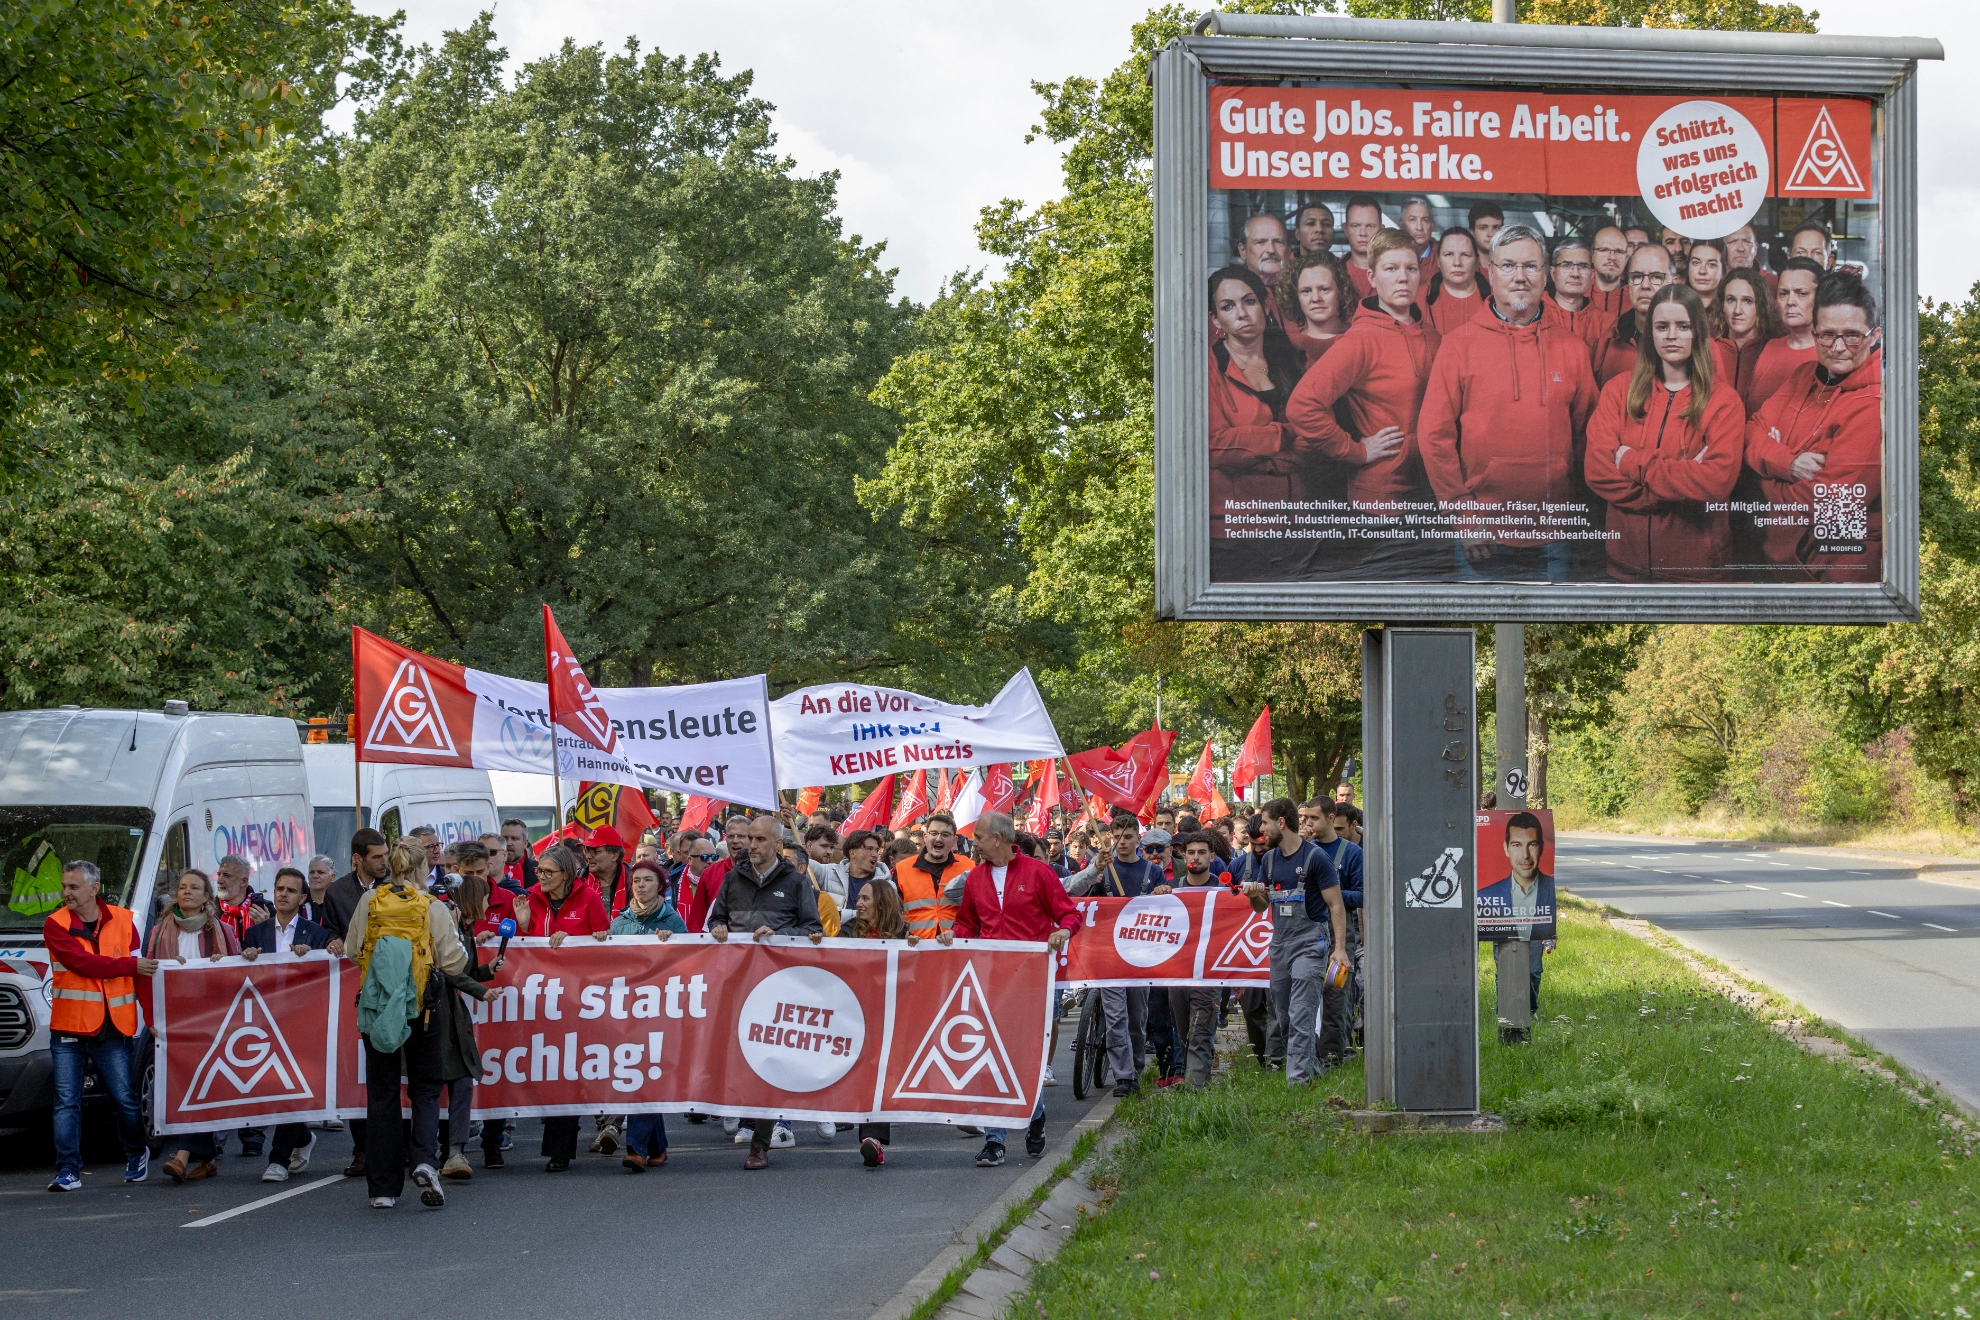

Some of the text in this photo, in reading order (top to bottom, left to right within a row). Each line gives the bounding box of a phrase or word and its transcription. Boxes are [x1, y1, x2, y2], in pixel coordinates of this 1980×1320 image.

[1219, 98, 1631, 144] Gute Jobs. Faire Arbeit.
[1656, 116, 1734, 147] Schützt,
[1220, 141, 1493, 181] Unsere Stärke.
[1662, 143, 1738, 172] was uns
[1653, 161, 1758, 199] erfolgreich
[1679, 189, 1744, 220] macht!
[1224, 499, 1351, 511] Maschinenbautechniker,
[1352, 500, 1437, 512] Kundenbetreuer,
[1438, 500, 1505, 512] Modellbauer,
[1506, 500, 1540, 512] Fräser,
[1705, 501, 1809, 513] Jetzt Mitglied werden
[1224, 514, 1292, 525] Betriebswirt,
[1294, 514, 1403, 526] Industriemechaniker,
[1404, 514, 1537, 527] Wirtschaftsinformatikerin,
[1754, 516, 1810, 528] igmetall.de
[1224, 528, 1283, 539] Technische
[1284, 528, 1346, 540] Assistentin,
[1348, 528, 1419, 540] IT-Consultant,
[1421, 529, 1496, 541] Informatikerin,
[799, 693, 832, 715] An
[837, 690, 872, 713] die
[852, 722, 894, 742] IHR
[829, 739, 974, 776] KEINE Nutzis
[1507, 771, 1527, 795] 96
[213, 821, 295, 866] OMEXOM
[426, 820, 483, 847] MEXOM
[1476, 896, 1507, 906] AXEL
[1476, 905, 1551, 917] VON DER OHE
[1134, 912, 1172, 928] JETZT
[1118, 926, 1181, 945] REICHT'S!
[461, 973, 708, 1025] unft statt
[772, 1002, 834, 1029] JETZT
[748, 1022, 852, 1057] REICHT'S!
